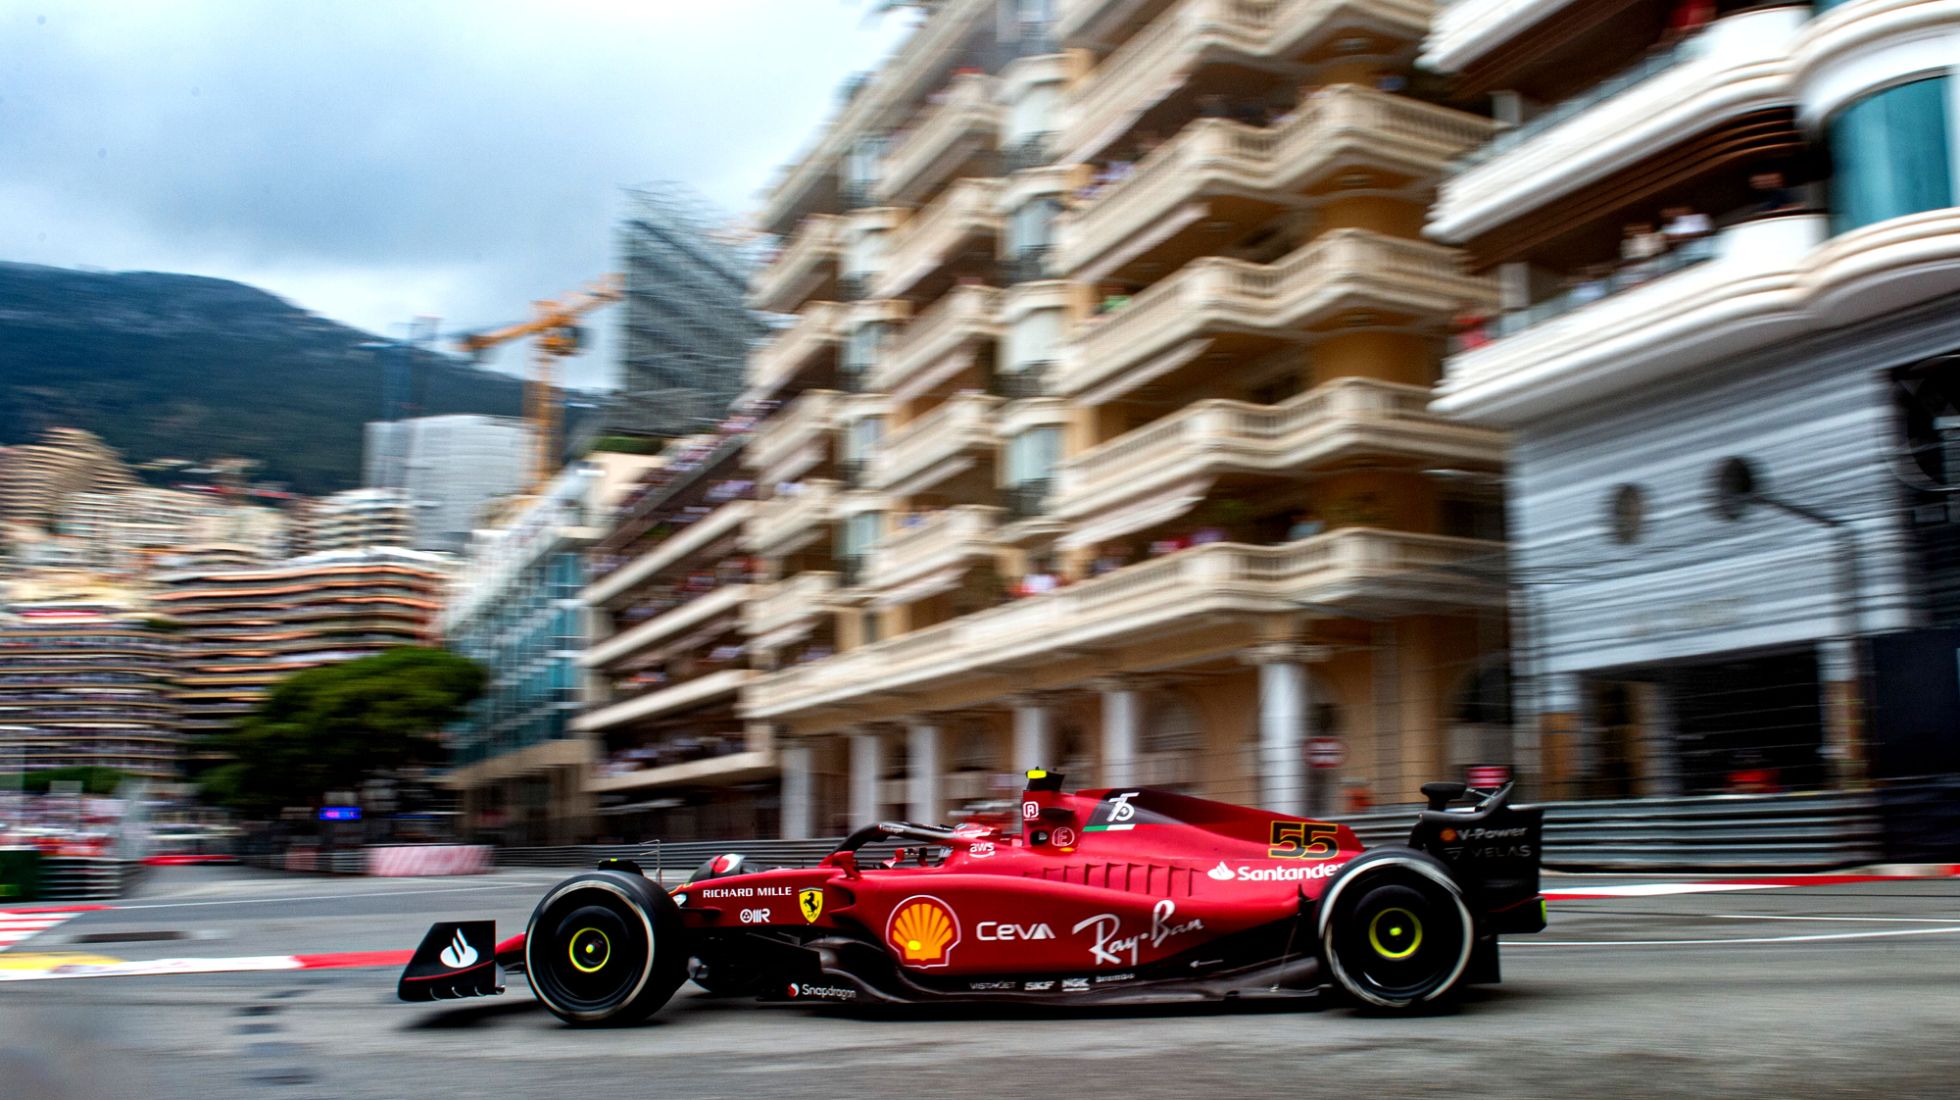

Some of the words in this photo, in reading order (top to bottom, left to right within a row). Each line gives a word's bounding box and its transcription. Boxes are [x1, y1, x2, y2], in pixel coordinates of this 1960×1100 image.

[1268, 820, 1339, 860] 55
[1457, 827, 1528, 840] V-Power
[969, 842, 995, 854] aws
[1471, 845, 1532, 857] VELAS
[702, 888, 754, 898] RICHARD
[757, 886, 792, 896] MILLE
[1072, 899, 1204, 966] Ray-Ban
[802, 983, 857, 1000] Snapdragon
